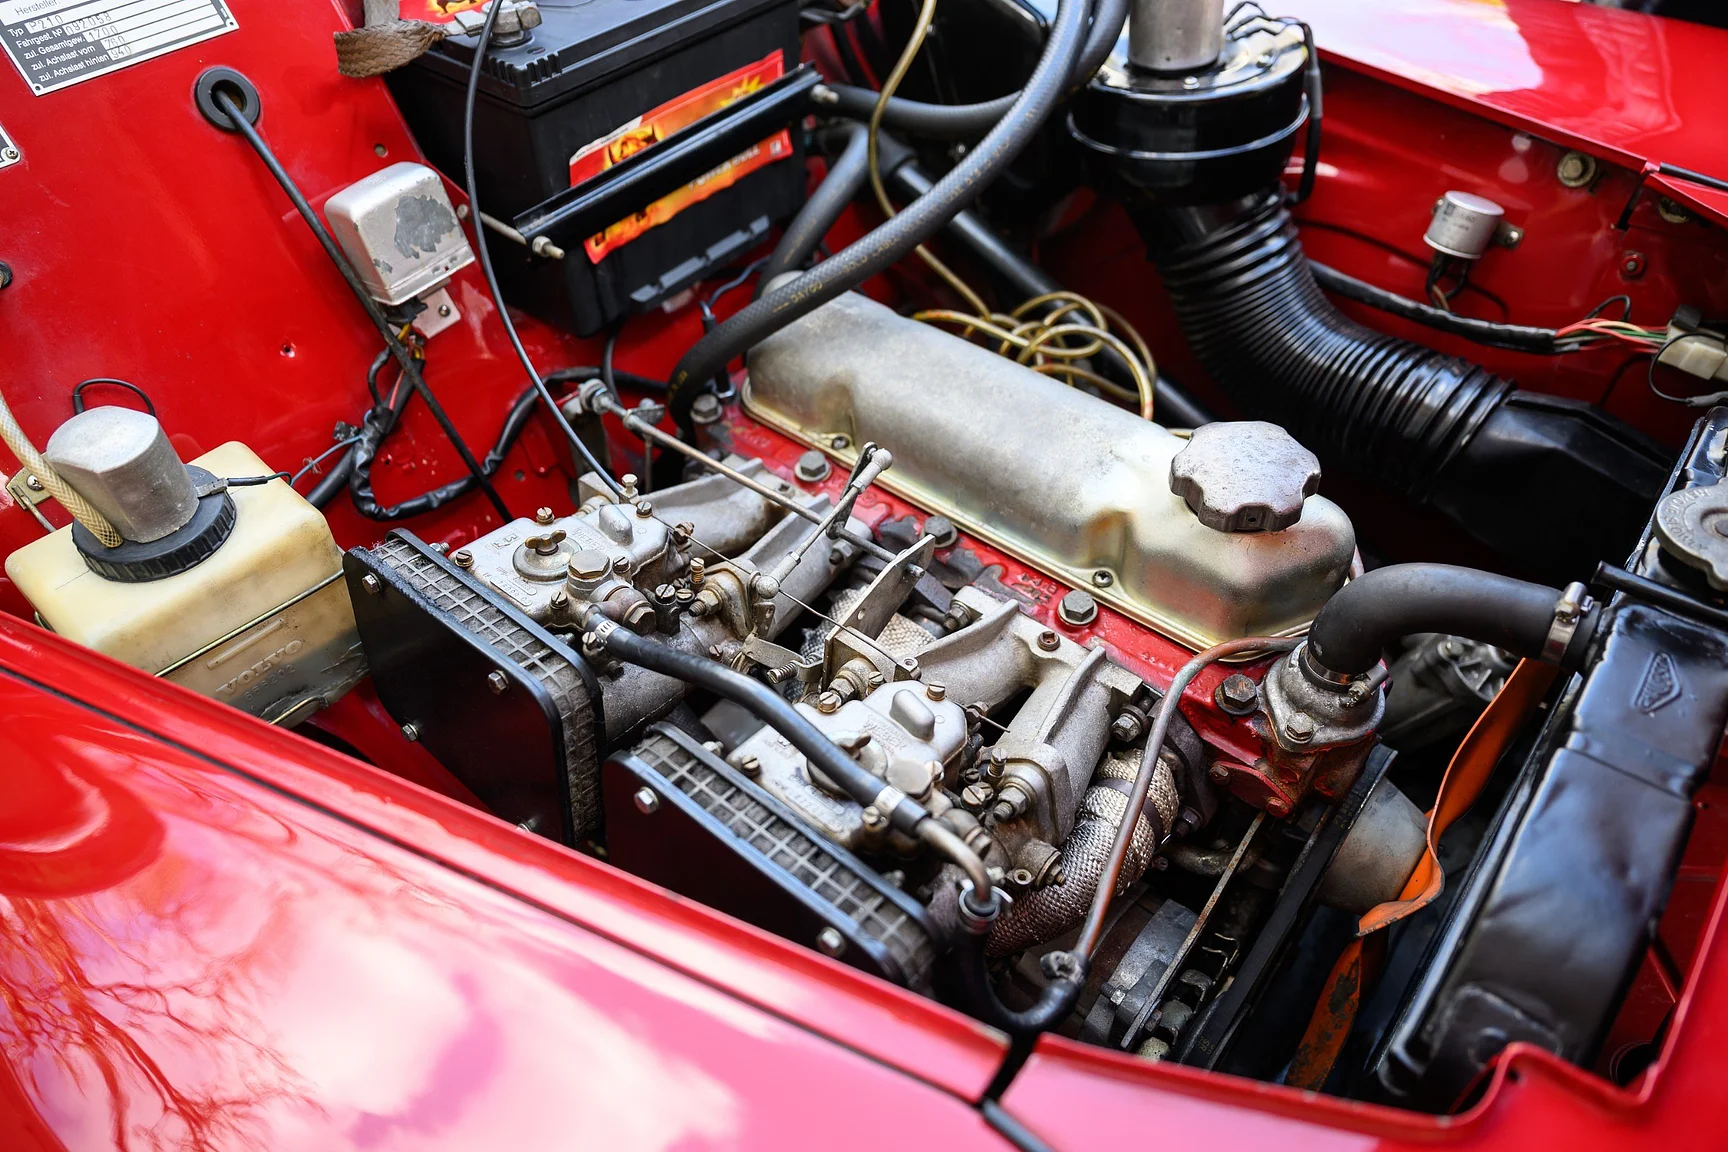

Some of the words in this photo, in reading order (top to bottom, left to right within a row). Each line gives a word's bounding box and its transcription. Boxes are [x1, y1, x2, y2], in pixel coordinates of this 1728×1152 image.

[7, 27, 25, 38] Typ
[29, 14, 64, 31] P210
[15, 33, 54, 49] Fahrgest.
[65, 12, 112, 36] 092058
[23, 49, 40, 60] zul.
[38, 36, 86, 56] Gesamtgew.
[88, 25, 119, 42] 1700
[31, 60, 47, 71] zul.
[46, 50, 79, 66] Achslast
[104, 35, 126, 48] 760
[38, 72, 54, 82] zul.
[54, 61, 87, 78] Achslast
[85, 54, 110, 67] hinten
[110, 45, 132, 59] 940
[216, 639, 304, 696] VOLVO
